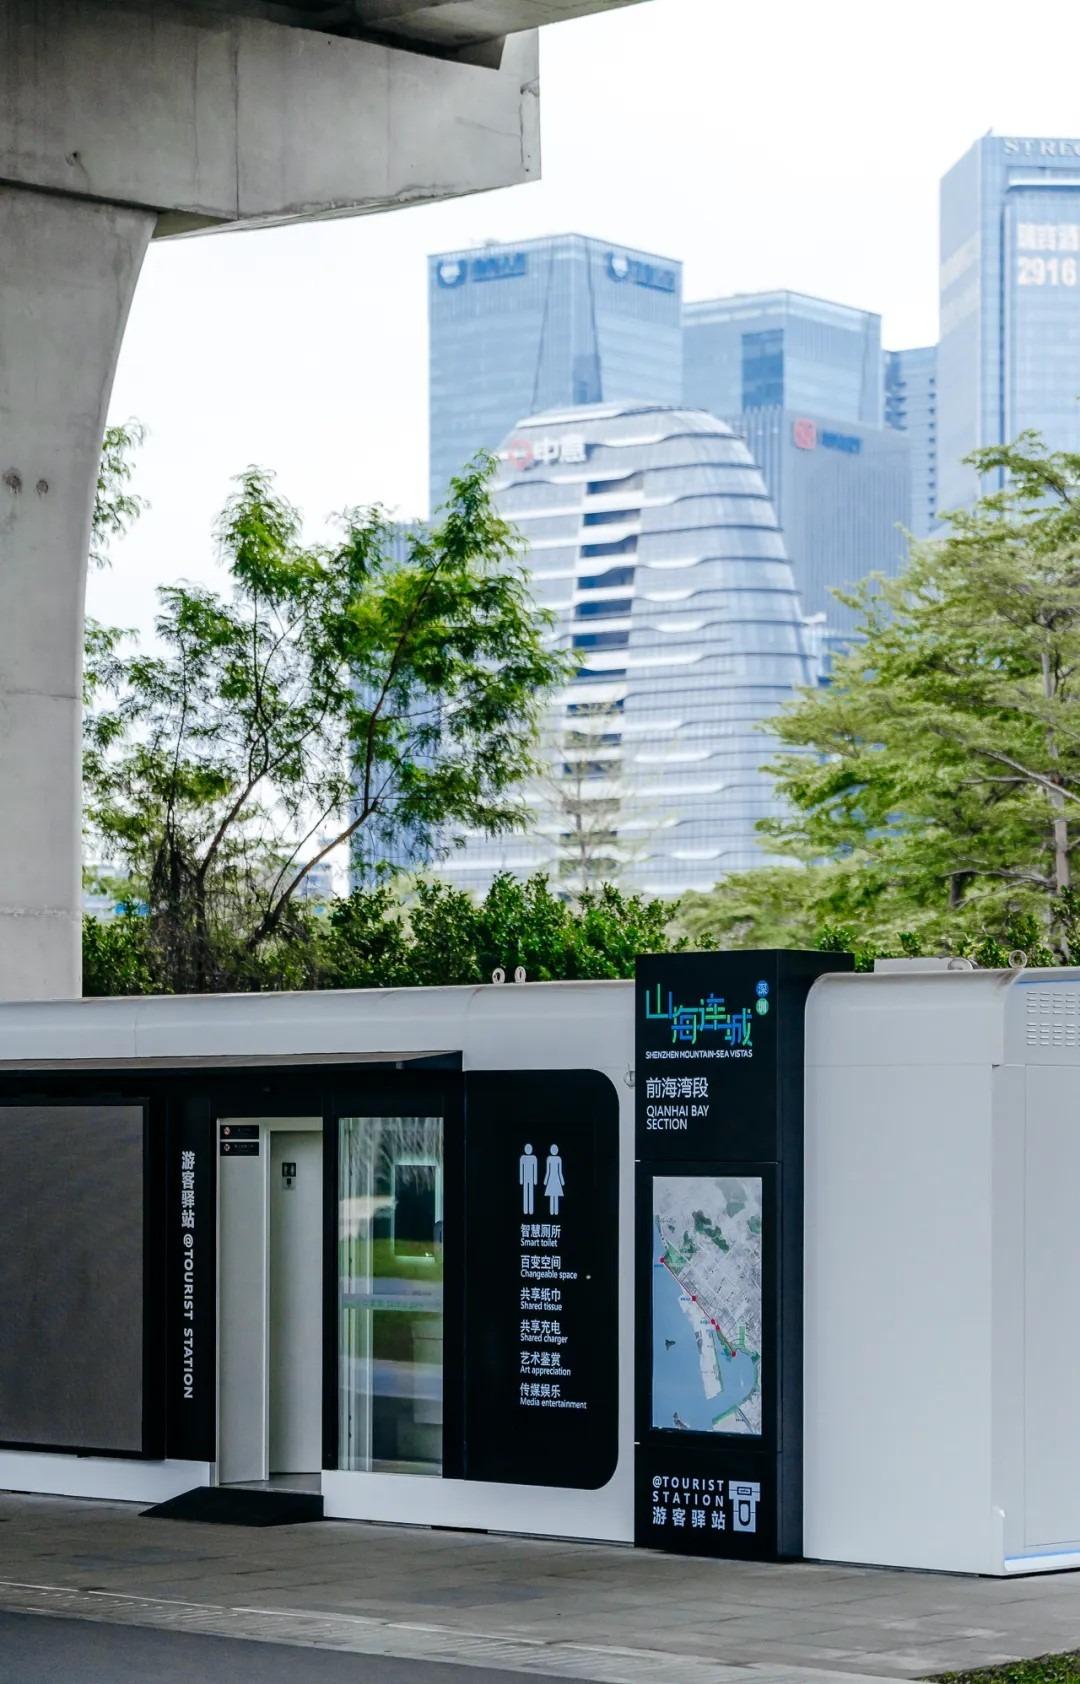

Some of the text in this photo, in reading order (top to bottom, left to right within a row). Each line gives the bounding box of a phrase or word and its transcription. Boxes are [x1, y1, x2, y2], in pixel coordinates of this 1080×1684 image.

[645, 1049, 753, 1059] SHENZHEN MOUNTAIN-SEA VISTAS
[646, 1076, 709, 1099] 前海湾段
[646, 1104, 710, 1118] QIANHAI BAY
[646, 1118, 688, 1130] SECTION
[181, 1150, 196, 1229] 游客驿站
[520, 1223, 562, 1238] 智慧厕所
[520, 1238, 558, 1247] Smart toilet
[520, 1255, 562, 1270] 百变空间
[520, 1269, 578, 1281] Changeable space
[520, 1287, 561, 1302] 共享纸巾
[520, 1301, 563, 1311] Shared tissue
[183, 1233, 195, 1399] @TOURIST STATION
[520, 1319, 561, 1335] 共享充电
[520, 1333, 568, 1345] Shared charger
[520, 1351, 561, 1366] 艺术鉴赏
[520, 1365, 571, 1377] Art appreciation
[520, 1382, 561, 1398] 传媒娱乐
[520, 1397, 587, 1409] Media entertainment
[652, 1475, 724, 1492] @TOURIST
[652, 1490, 724, 1507] STATION
[652, 1506, 726, 1531] 游客驿站
